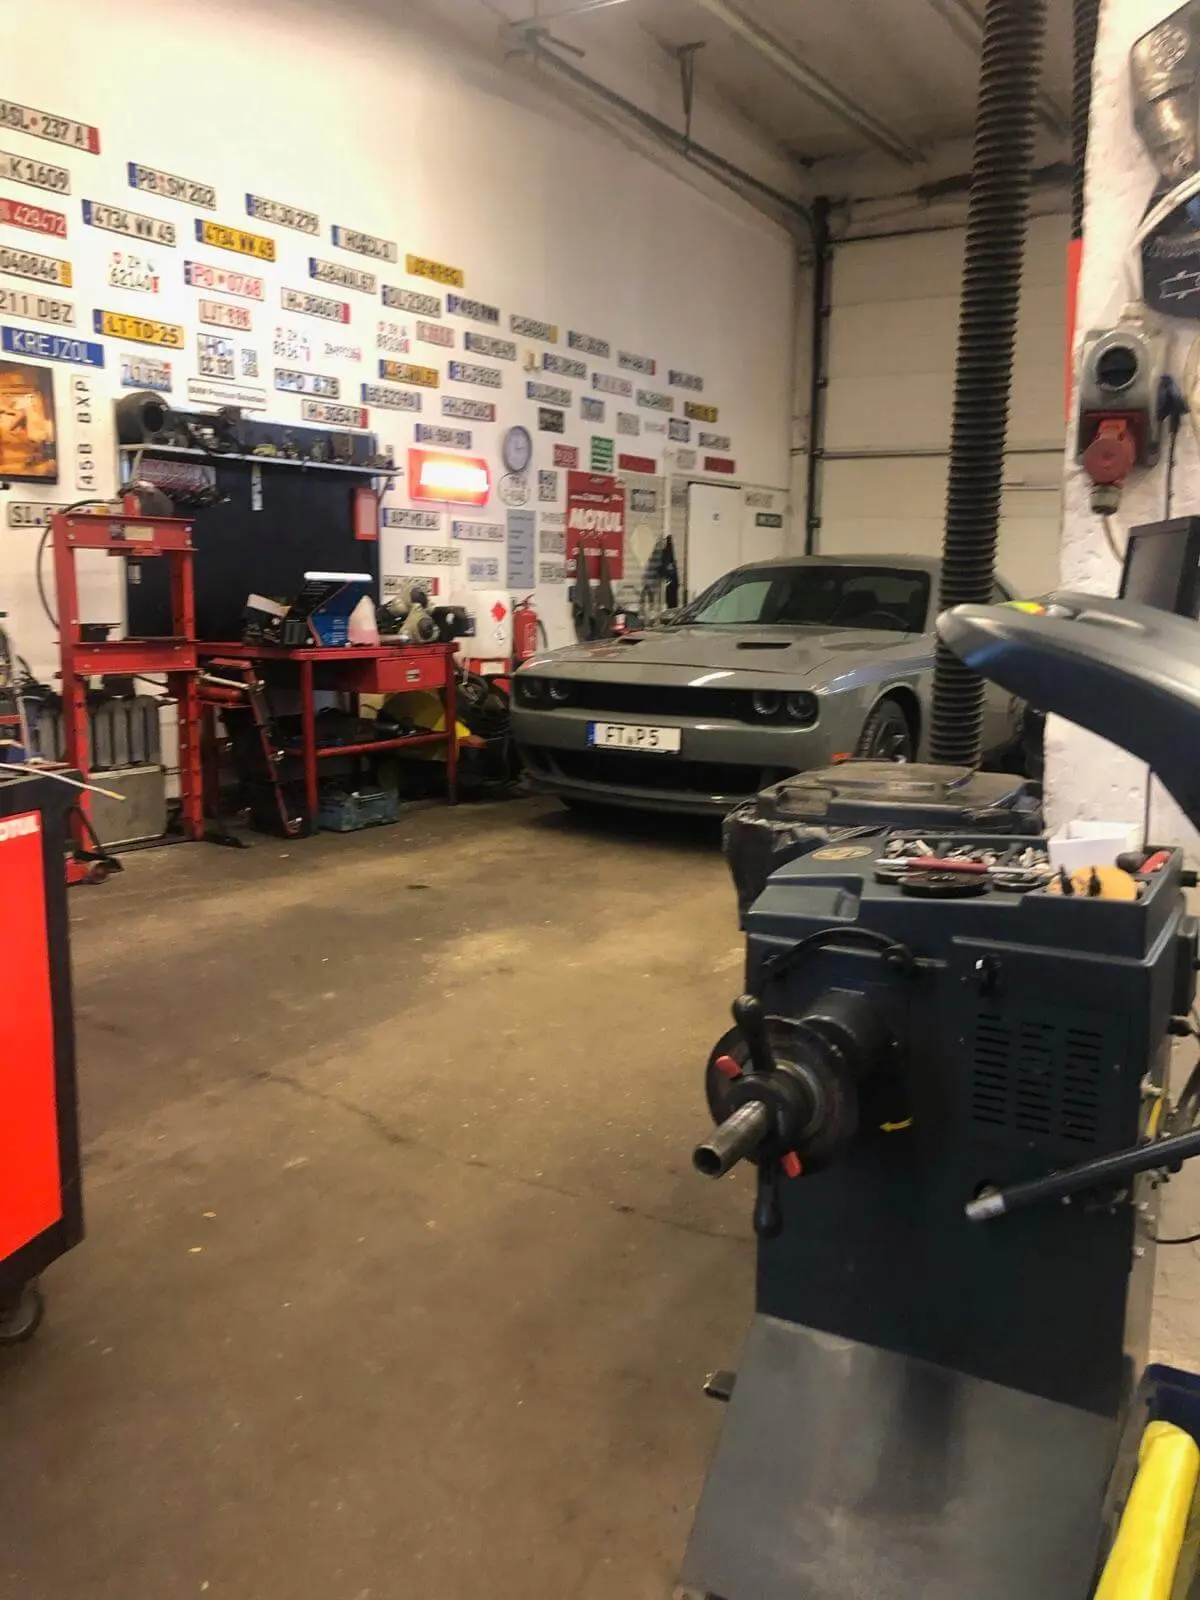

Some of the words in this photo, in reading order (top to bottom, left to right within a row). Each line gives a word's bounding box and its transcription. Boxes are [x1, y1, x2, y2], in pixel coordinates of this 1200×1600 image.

[41, 115, 70, 141] 237
[74, 125, 85, 146] A
[95, 206, 129, 231] 4734
[37, 298, 73, 324] DBZ
[12, 330, 95, 363] KREJZOL
[568, 508, 623, 533] MOTUL
[605, 725, 626, 744] FT
